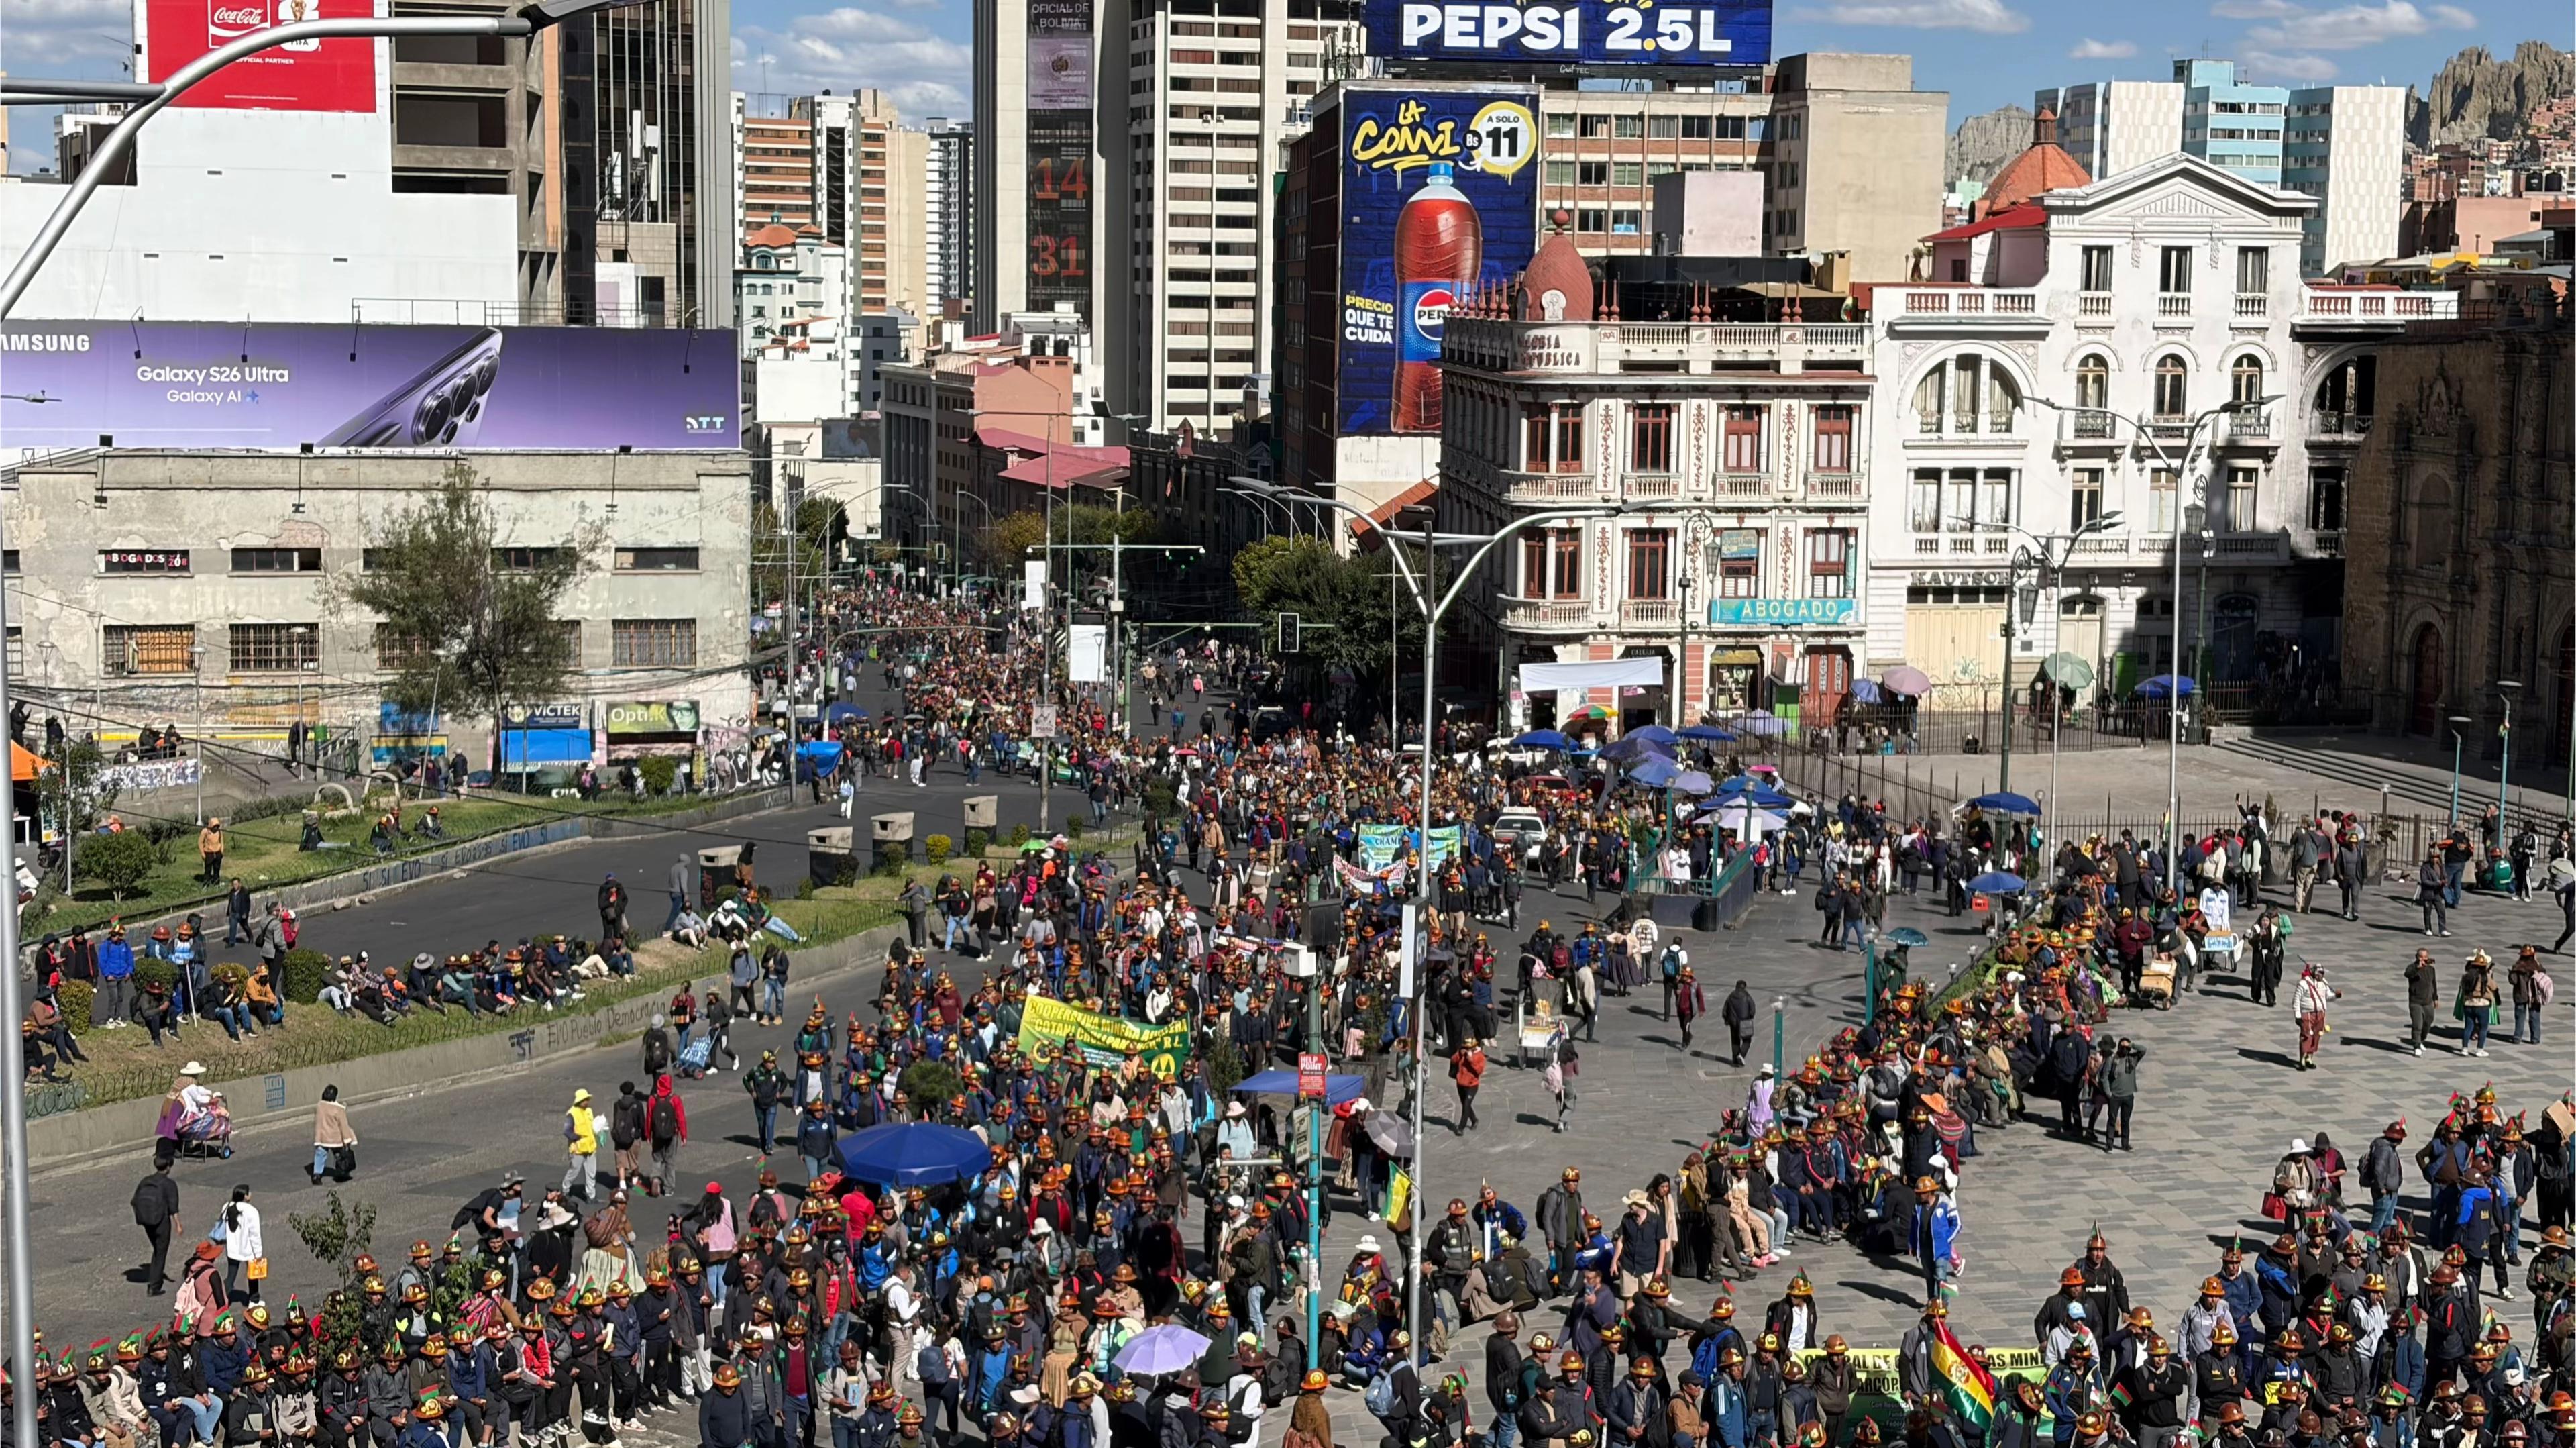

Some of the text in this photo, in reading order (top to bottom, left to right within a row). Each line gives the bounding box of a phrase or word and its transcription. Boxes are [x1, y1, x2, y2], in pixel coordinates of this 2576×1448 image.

[213, 7, 264, 24] Coca-Cola
[1032, 3, 1090, 13] OFICIAL DE
[1403, 4, 1732, 52] PEPSI 2.5L
[1399, 100, 1426, 125] LA
[1487, 115, 1520, 123] A SOLO
[1466, 126, 1519, 158] Bs 11
[1031, 157, 1088, 199] 14
[1030, 234, 1085, 276] 31
[1345, 294, 1394, 314] PRECIO
[1344, 308, 1394, 329] QUE TE
[0, 335, 89, 351] AMSUNG
[1344, 326, 1393, 344] CUIDA
[136, 366, 289, 386] Galaxy S26 Ultra
[166, 389, 241, 406] Galaxy AI
[1910, 570, 2012, 586] KAUTSCH
[1742, 601, 1837, 617] ABOGADO
[533, 705, 581, 717] VICTEK
[513, 829, 530, 852] EVO
[1028, 1000, 1099, 1029] COOPERATIVA
[1101, 1018, 1140, 1041] MINERA
[547, 1021, 569, 1049] EVO
[1301, 1062, 1322, 1070] POINT
[1857, 1376, 1899, 1394] ARCOP
